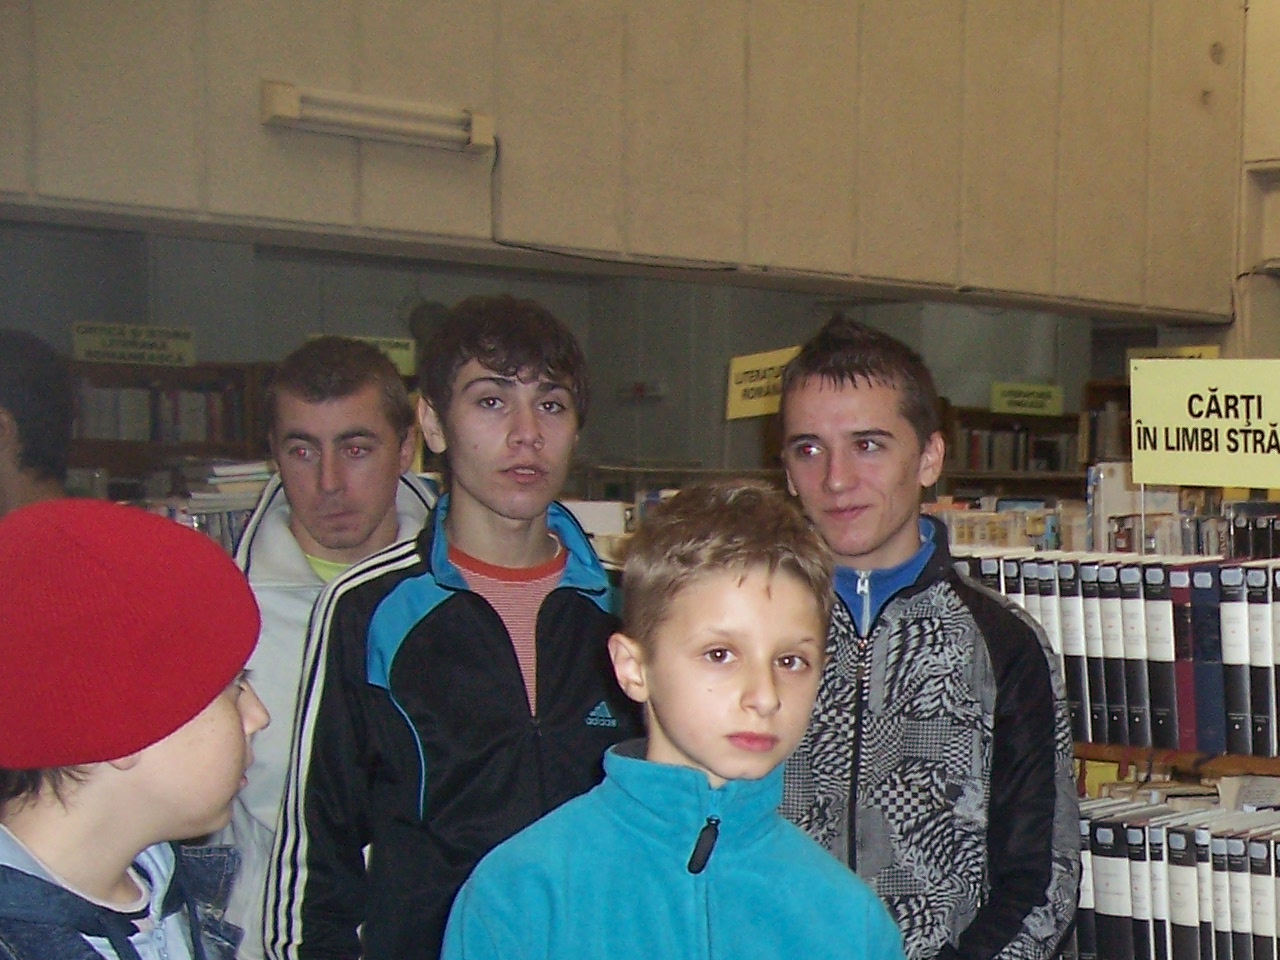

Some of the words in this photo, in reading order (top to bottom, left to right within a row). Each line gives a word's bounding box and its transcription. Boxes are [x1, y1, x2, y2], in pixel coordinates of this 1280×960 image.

[1135, 419, 1157, 451] ÎN
[1164, 426, 1219, 453] LIMBI
[585, 717, 618, 728] adidas
